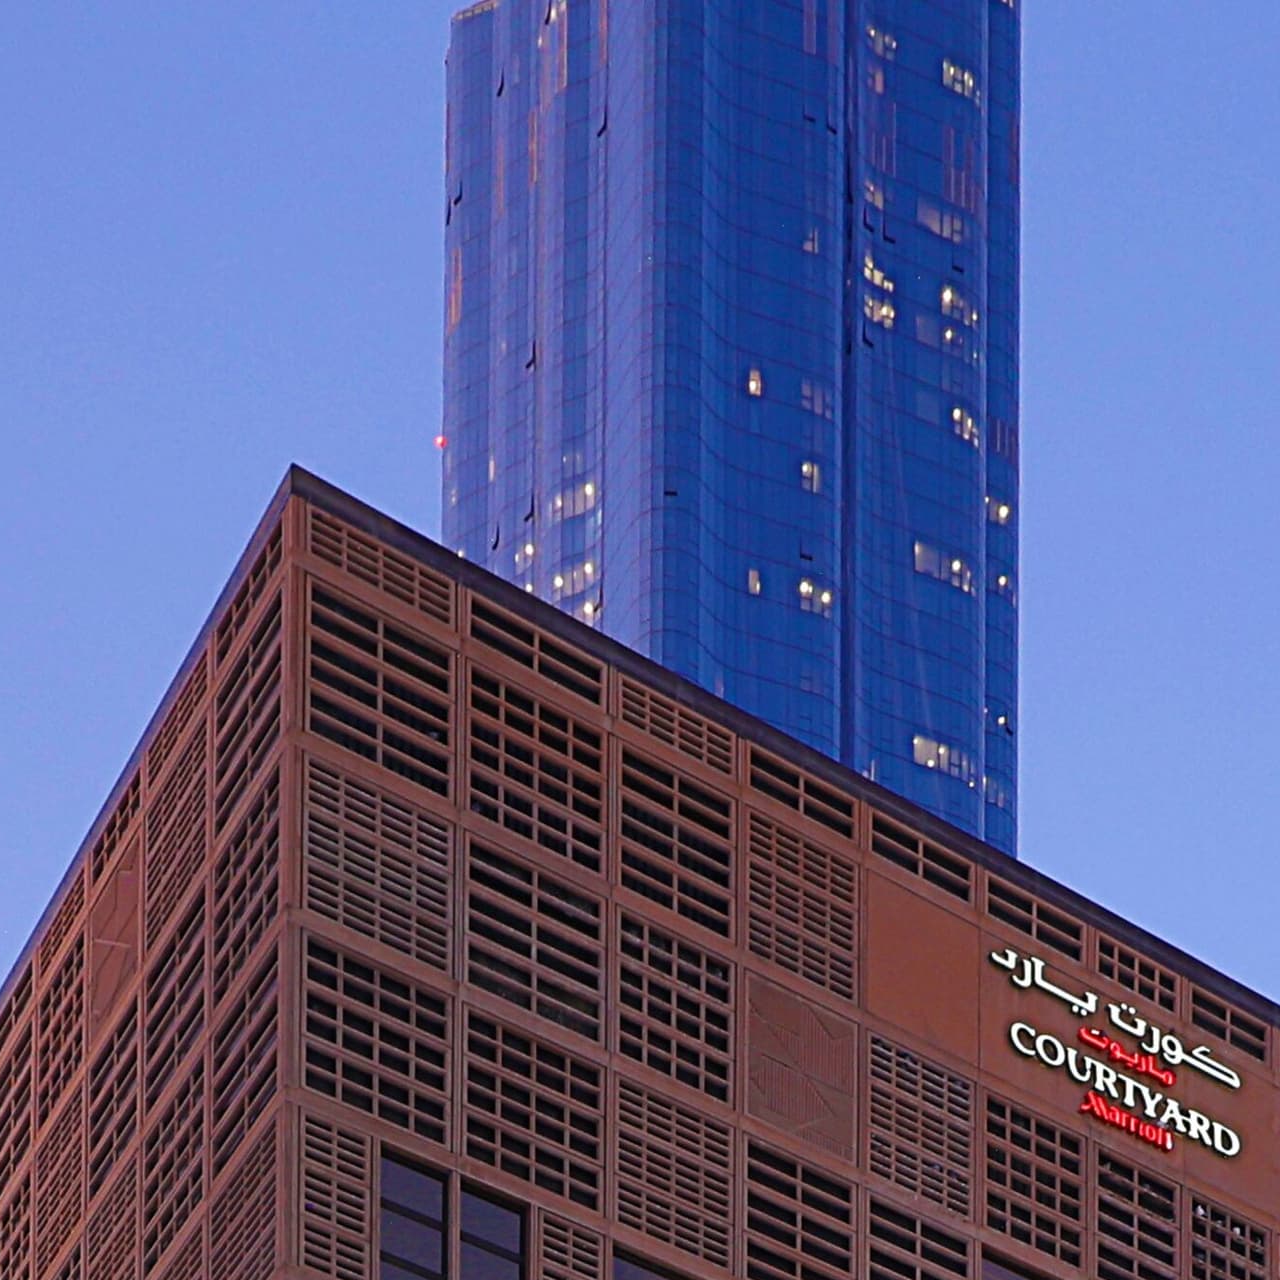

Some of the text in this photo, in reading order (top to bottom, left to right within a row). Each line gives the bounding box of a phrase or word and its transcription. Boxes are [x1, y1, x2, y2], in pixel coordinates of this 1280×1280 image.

[990, 948, 1241, 1090] كورت يارد
[1078, 1024, 1177, 1087] ماريوت
[1009, 1021, 1242, 1157] COURTYARD
[1079, 1089, 1175, 1152] Marriott
